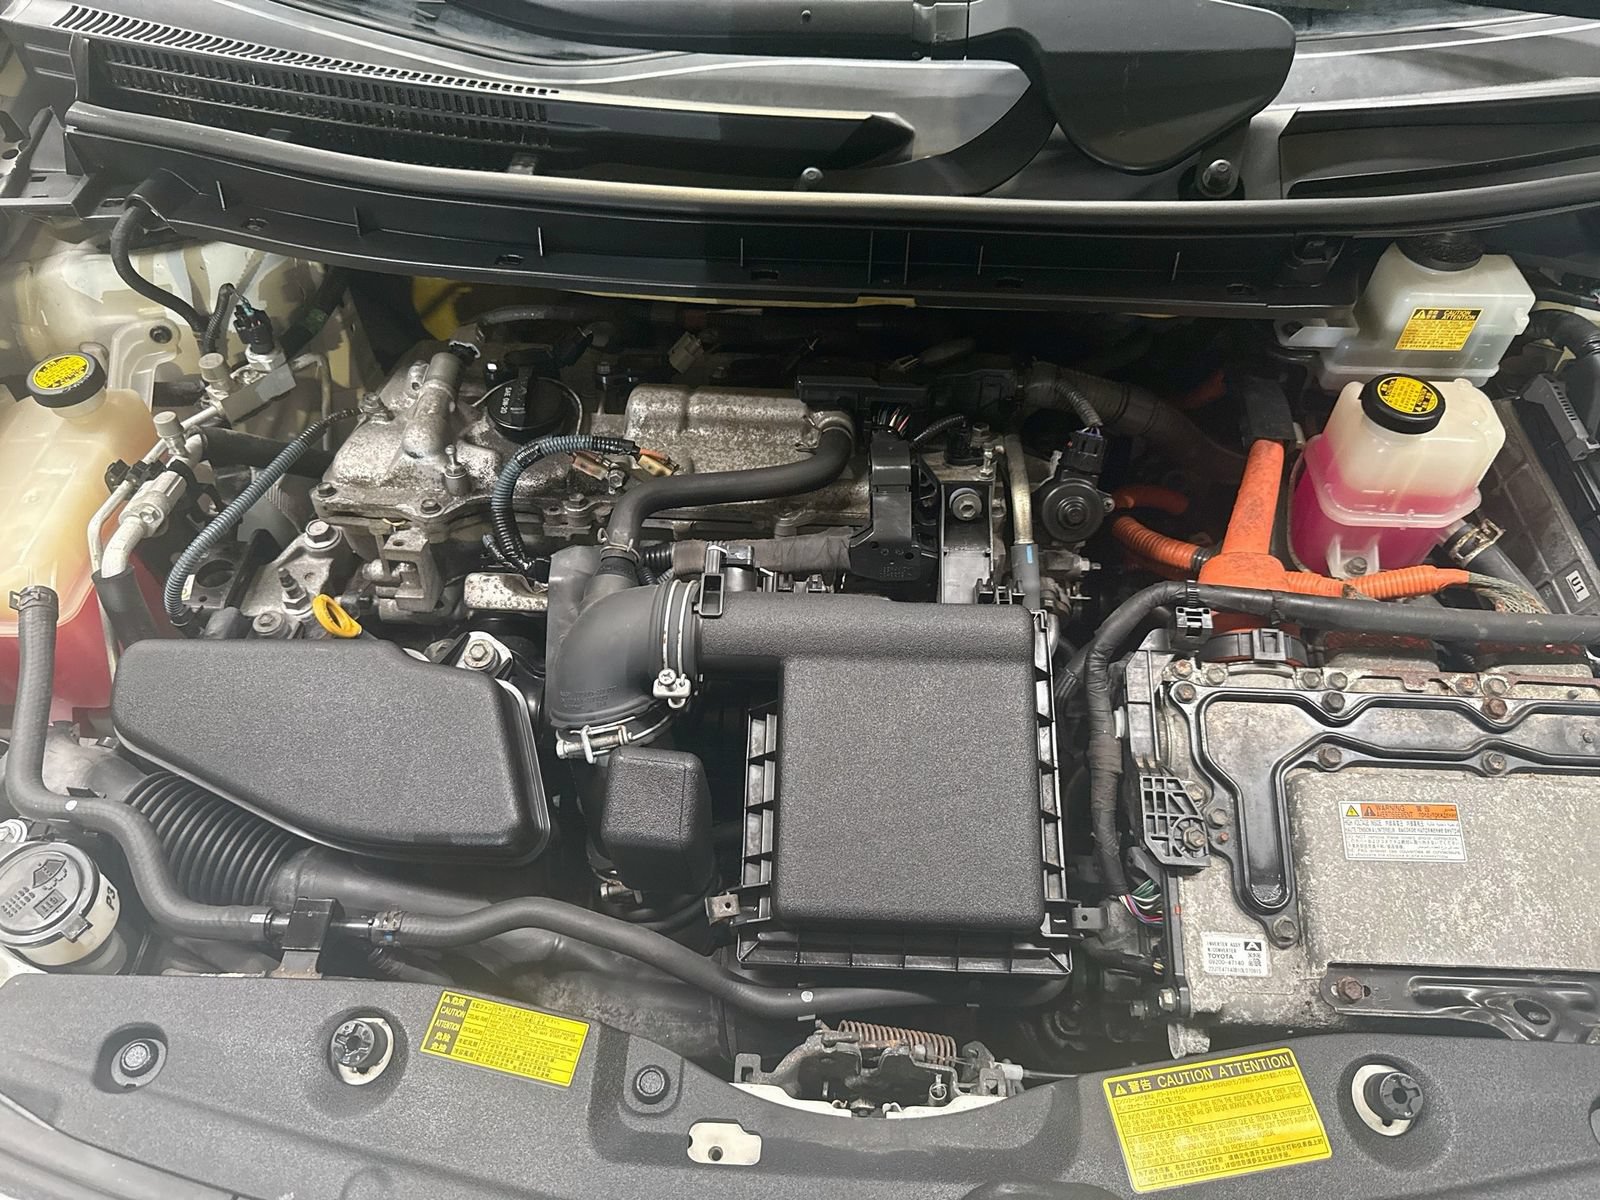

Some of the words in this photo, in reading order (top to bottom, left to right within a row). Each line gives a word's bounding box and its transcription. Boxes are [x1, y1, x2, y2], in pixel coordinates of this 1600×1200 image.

[504, 387, 512, 397] SAE
[1571, 576, 1584, 593] U1
[106, 886, 116, 911] P3
[440, 1006, 466, 1018] CAUTION
[435, 1019, 461, 1031] ATTENTION
[1157, 1068, 1213, 1088] CAUTION
[1219, 1055, 1291, 1077] ATTENTION
[1128, 1078, 1152, 1093] 警告
